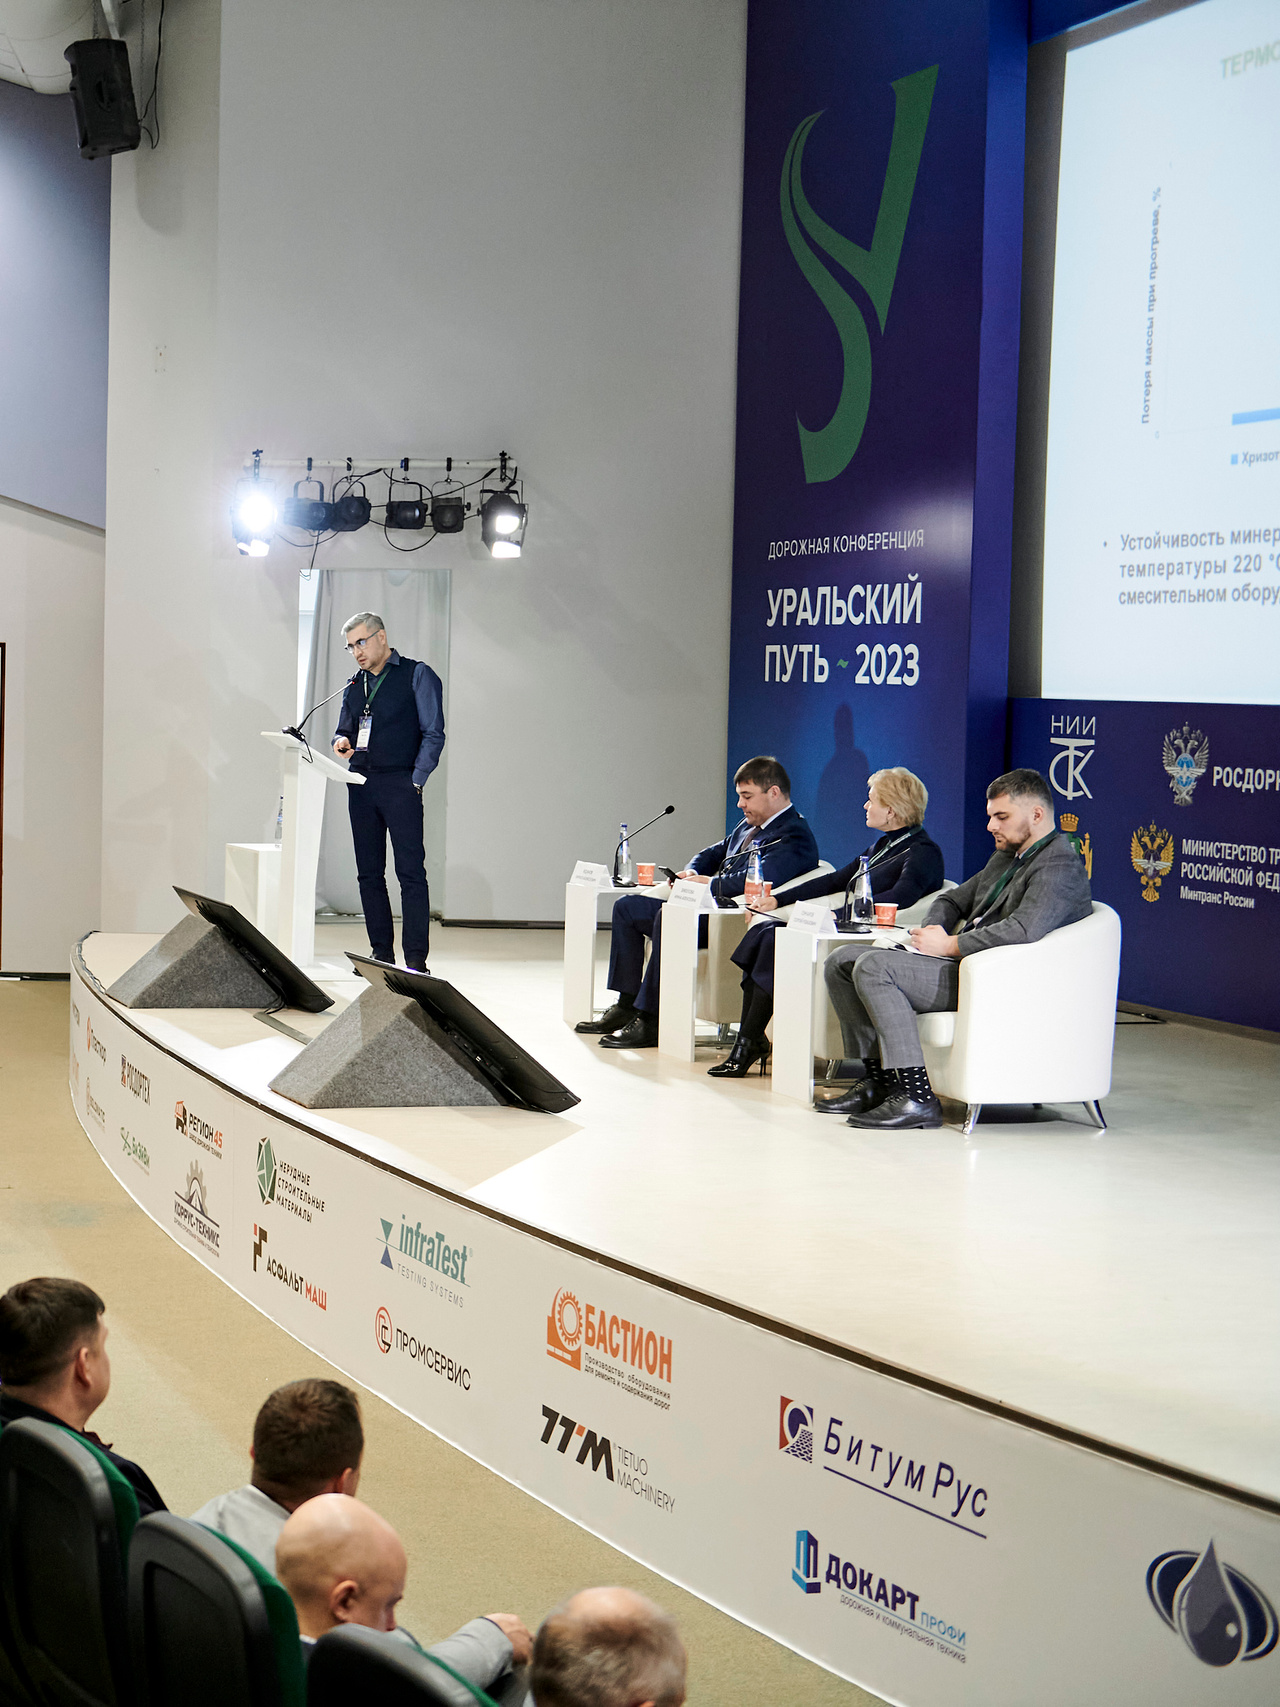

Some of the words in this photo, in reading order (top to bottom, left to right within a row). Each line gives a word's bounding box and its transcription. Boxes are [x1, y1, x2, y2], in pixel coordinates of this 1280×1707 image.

[1148, 284, 1157, 312] при
[1145, 317, 1155, 366] массы
[1141, 370, 1152, 424] Потеря
[768, 537, 830, 560] ДОРОЖНАЯ
[833, 529, 924, 553] КОНФЕРЕНЦИЯ
[1120, 531, 1225, 551] Устойчивость
[1119, 559, 1227, 580] температуры
[1233, 554, 1262, 573] 220
[766, 573, 922, 627] УРАЛЬСКИЙ
[1119, 588, 1227, 605] смесительном
[764, 644, 830, 683] ПУТЬ
[855, 643, 920, 687] 2023
[1051, 715, 1096, 736] НИИ
[1182, 839, 1267, 864] МИНИСТЕРСТВО
[1181, 861, 1253, 886] РОССИЙСКОЙ
[1180, 886, 1222, 904] Минтранс
[1223, 892, 1255, 909] России
[188, 1113, 214, 1143] РЕГИОН
[214, 1130, 223, 1149] 45
[279, 1160, 311, 1187] НЕРУДНЫЕ
[276, 1194, 313, 1223] МАТЕРИАЛЫ
[277, 1177, 325, 1213] СТРОИТЕЛЬНЫЕ
[267, 1256, 304, 1295] АСФАЛЬТ
[305, 1280, 327, 1312] МАШ
[397, 1263, 427, 1288] TESTING
[429, 1280, 464, 1308] SYSTEMS
[396, 1328, 471, 1391] ПРОМСЕРВИС
[585, 1303, 673, 1384] БАСТИОН
[584, 1352, 625, 1379] Производство
[628, 1374, 671, 1400] оборудования
[594, 1369, 616, 1385] ремонта
[621, 1381, 653, 1403] содержания
[618, 1446, 648, 1476] TIETUO
[617, 1468, 676, 1513] MACHINERY
[825, 1553, 920, 1621] ДОКАРТ
[921, 1611, 967, 1645] ПРОФИ
[840, 1593, 875, 1618] дорожная
[881, 1616, 935, 1648] коммунальная
[936, 1641, 967, 1664] техника
